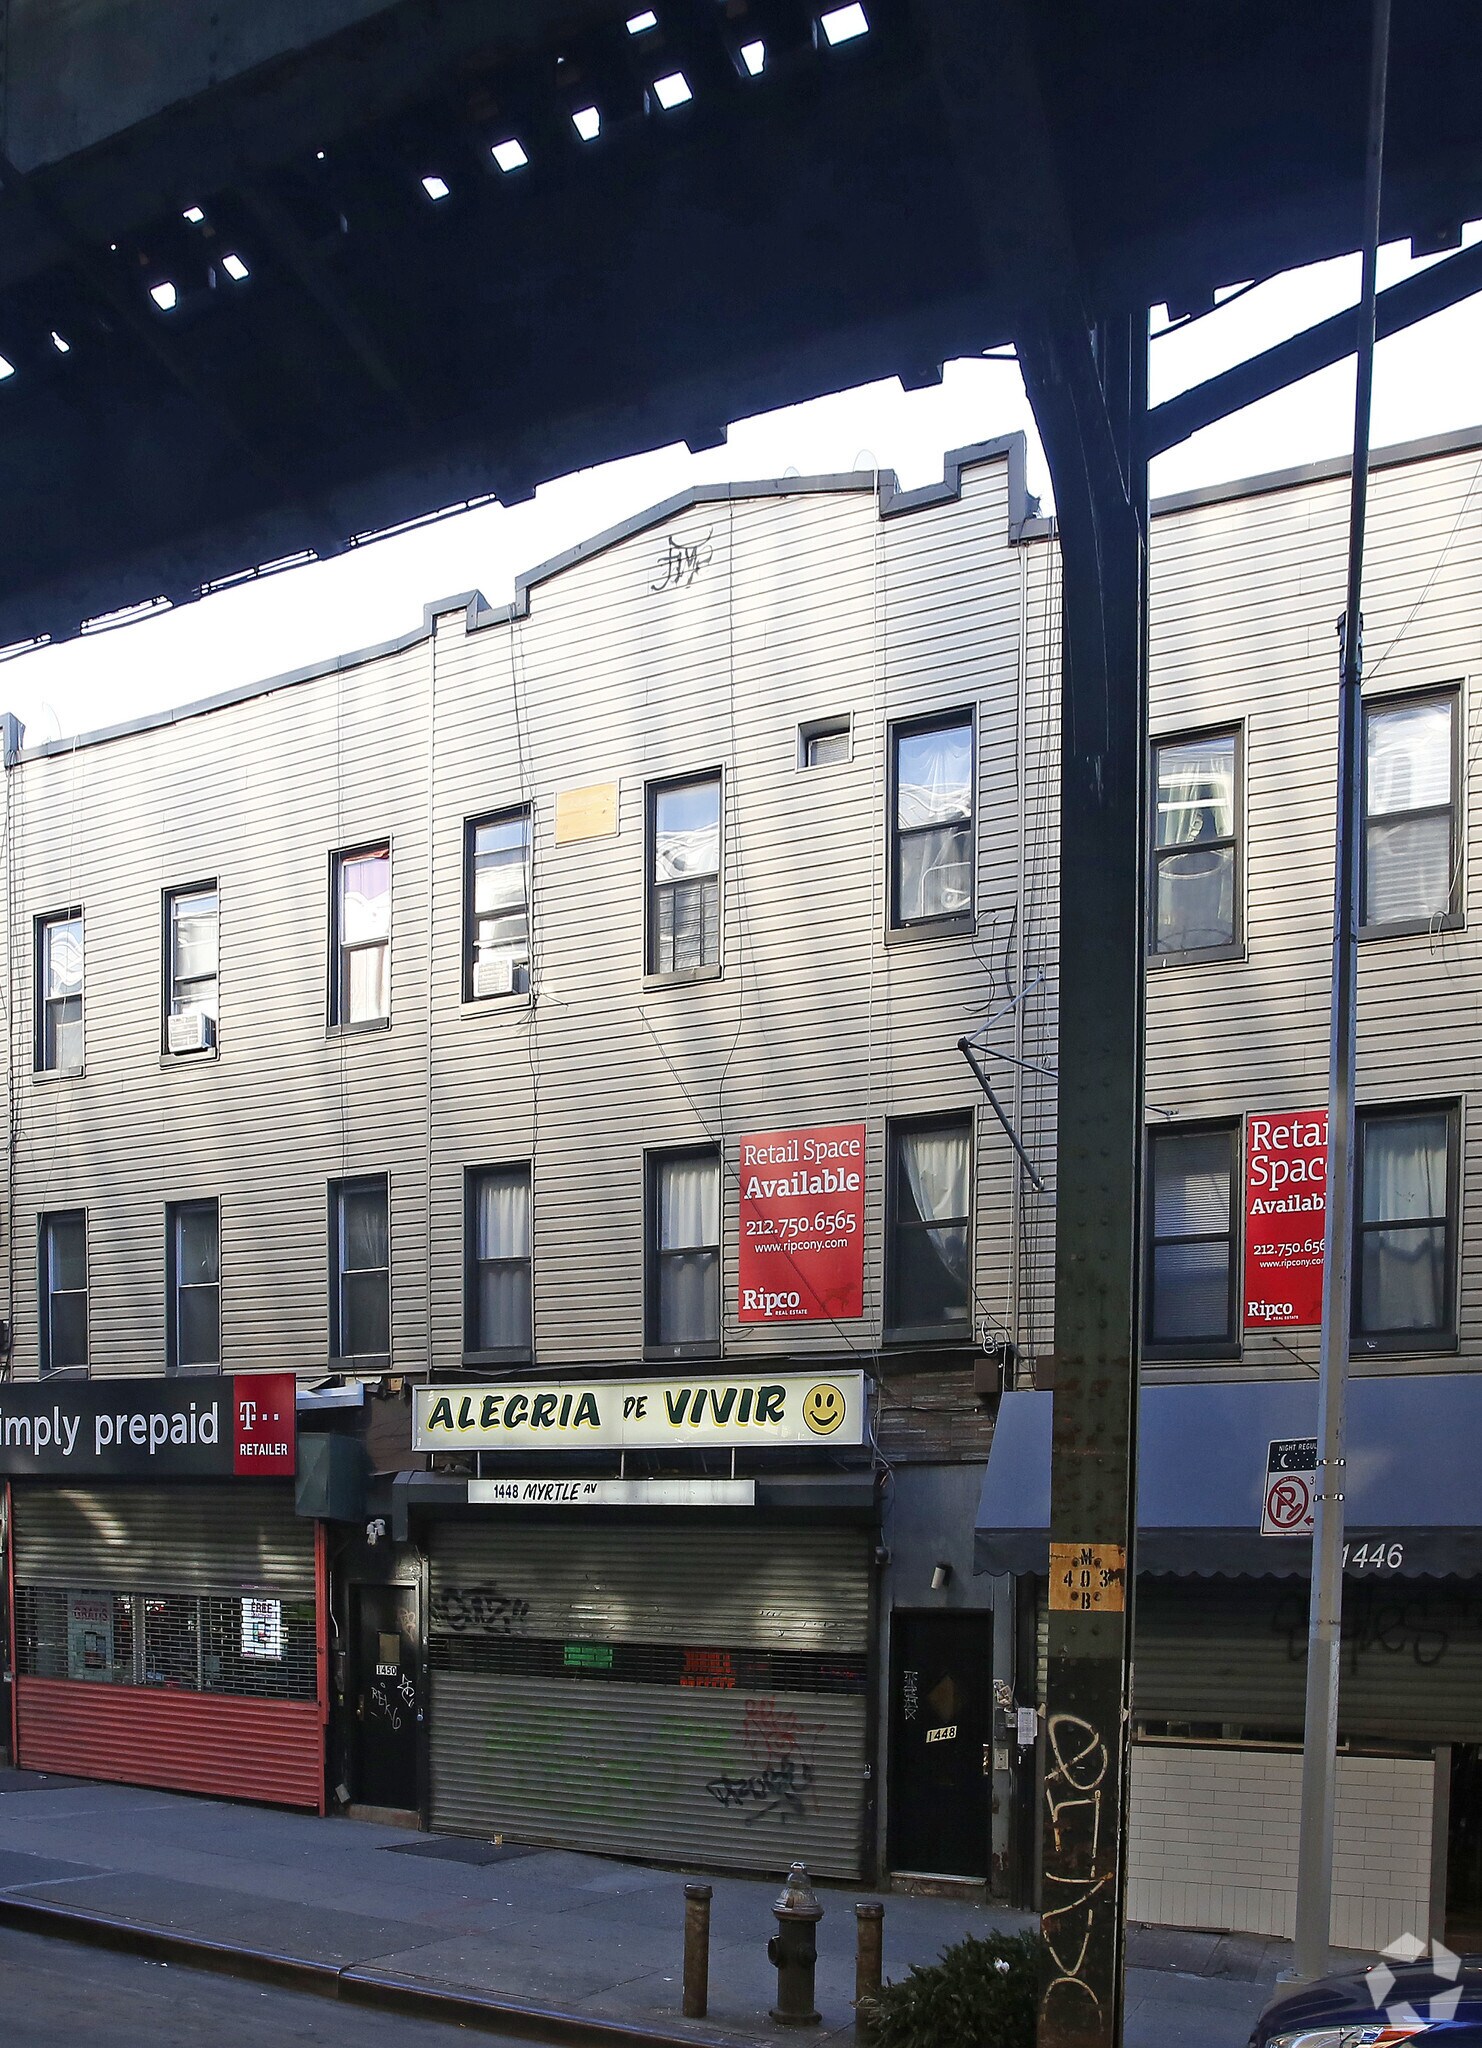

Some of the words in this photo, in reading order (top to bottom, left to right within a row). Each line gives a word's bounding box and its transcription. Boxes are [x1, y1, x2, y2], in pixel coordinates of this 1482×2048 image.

[1251, 1113, 1329, 1151] Retai
[744, 1139, 799, 1166] Retail
[803, 1138, 860, 1164] Space
[743, 1167, 860, 1200] Available
[1250, 1155, 1328, 1192] Spac
[1250, 1193, 1326, 1215] Availab
[746, 1209, 856, 1238] 212.750.6565
[754, 1238, 848, 1254] www.ripcony.com
[1253, 1238, 1325, 1257] 212.750.656
[742, 1287, 801, 1316] Ripco
[1247, 1299, 1293, 1321] Ripco
[428, 1392, 602, 1431] ALEGRIA
[623, 1395, 649, 1421] DE
[664, 1384, 787, 1428] VIVIR
[0, 1406, 80, 1455] mply
[95, 1402, 219, 1455] prepaid
[239, 1443, 288, 1456] RETAILER
[1278, 1444, 1297, 1452] NIGHT
[1298, 1443, 1318, 1451] REGUL
[493, 1483, 519, 1500] 1448
[523, 1483, 580, 1502] MYRTLE
[583, 1482, 598, 1495] AV
[1081, 1548, 1093, 1565] M
[1342, 1543, 1404, 1569] 1446
[251, 1602, 273, 1613] FREE
[1081, 1592, 1091, 1609] B
[377, 1665, 397, 1675] 1450
[928, 1727, 956, 1742] 1448
